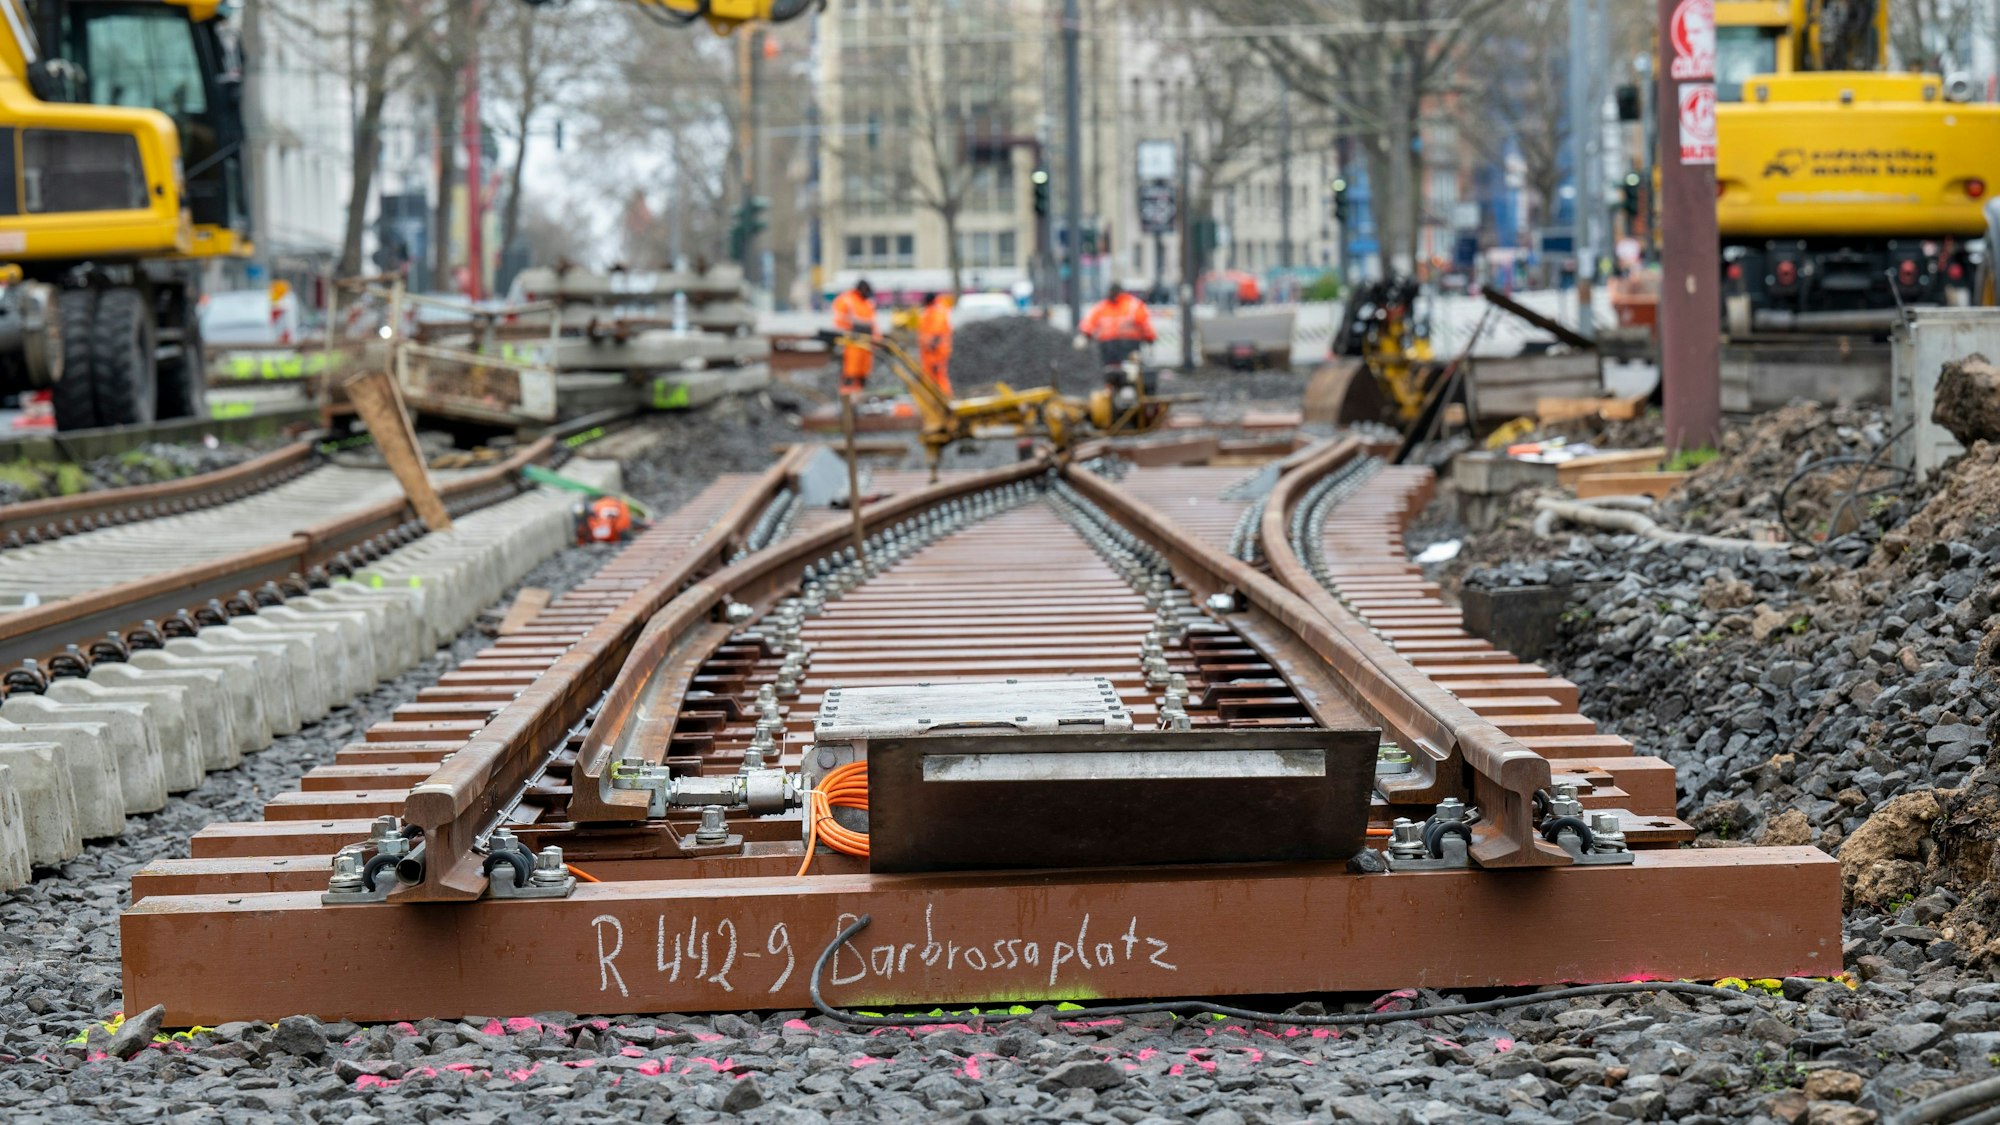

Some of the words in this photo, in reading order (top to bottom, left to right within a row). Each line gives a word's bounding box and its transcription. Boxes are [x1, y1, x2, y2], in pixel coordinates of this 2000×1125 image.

[591, 914, 629, 998] R
[657, 914, 795, 993] 442-9
[831, 903, 1178, 986] Barbrossaplatz
